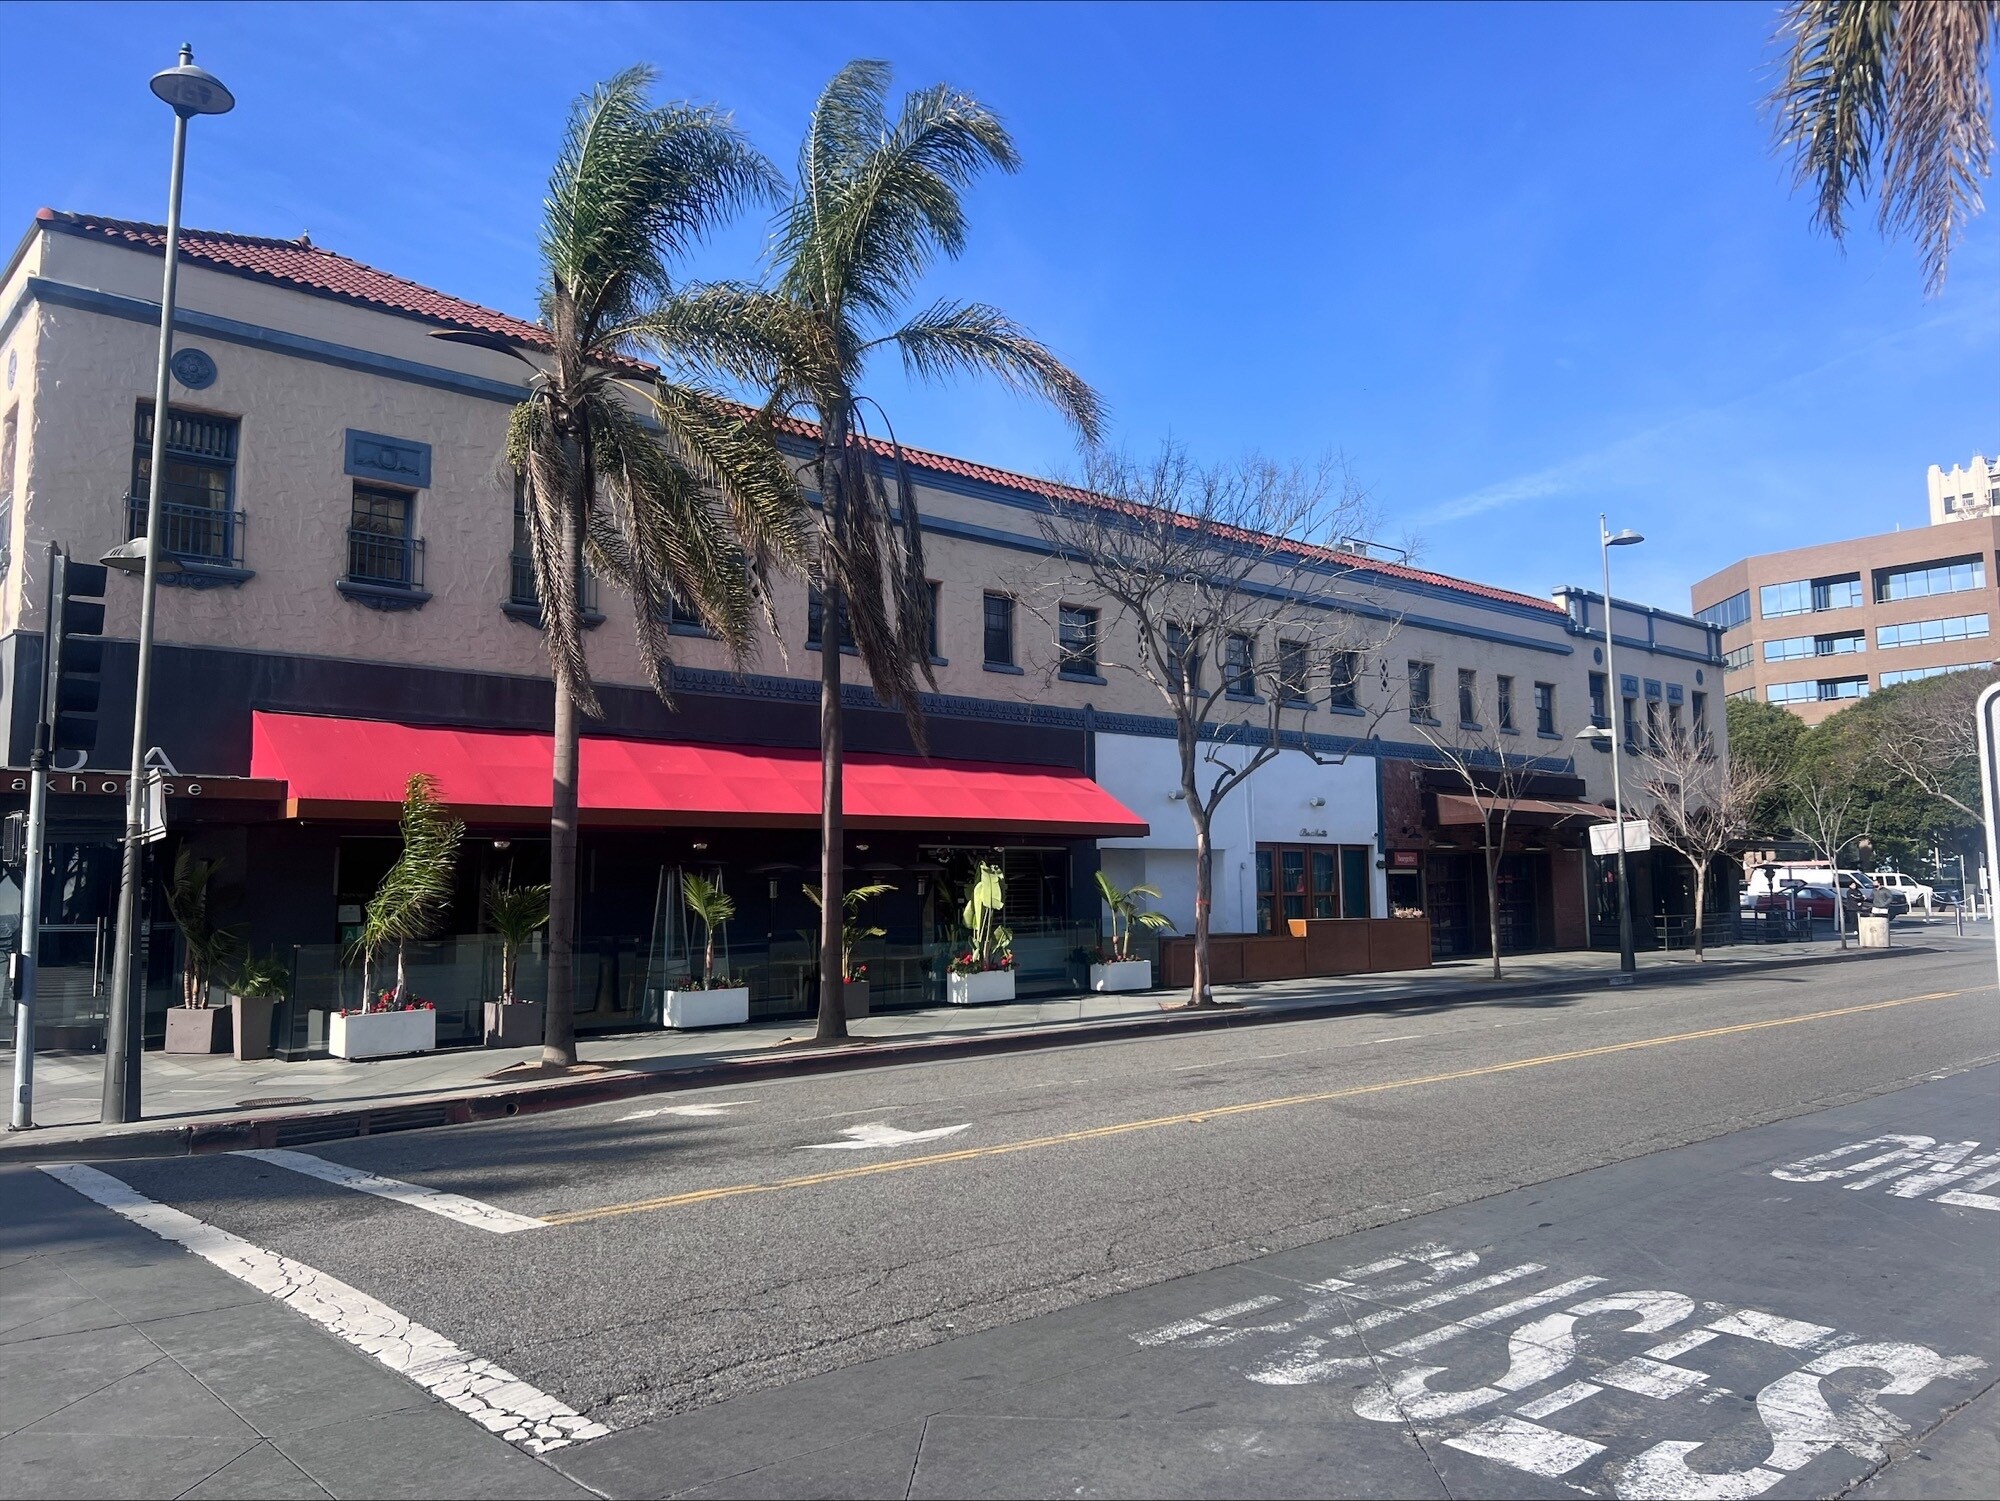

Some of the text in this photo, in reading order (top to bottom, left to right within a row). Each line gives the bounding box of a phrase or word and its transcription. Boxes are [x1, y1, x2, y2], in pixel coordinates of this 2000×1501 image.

[11, 775, 203, 797] akhose
[344, 930, 354, 941] A
[1127, 1242, 1988, 1499] BUSES
